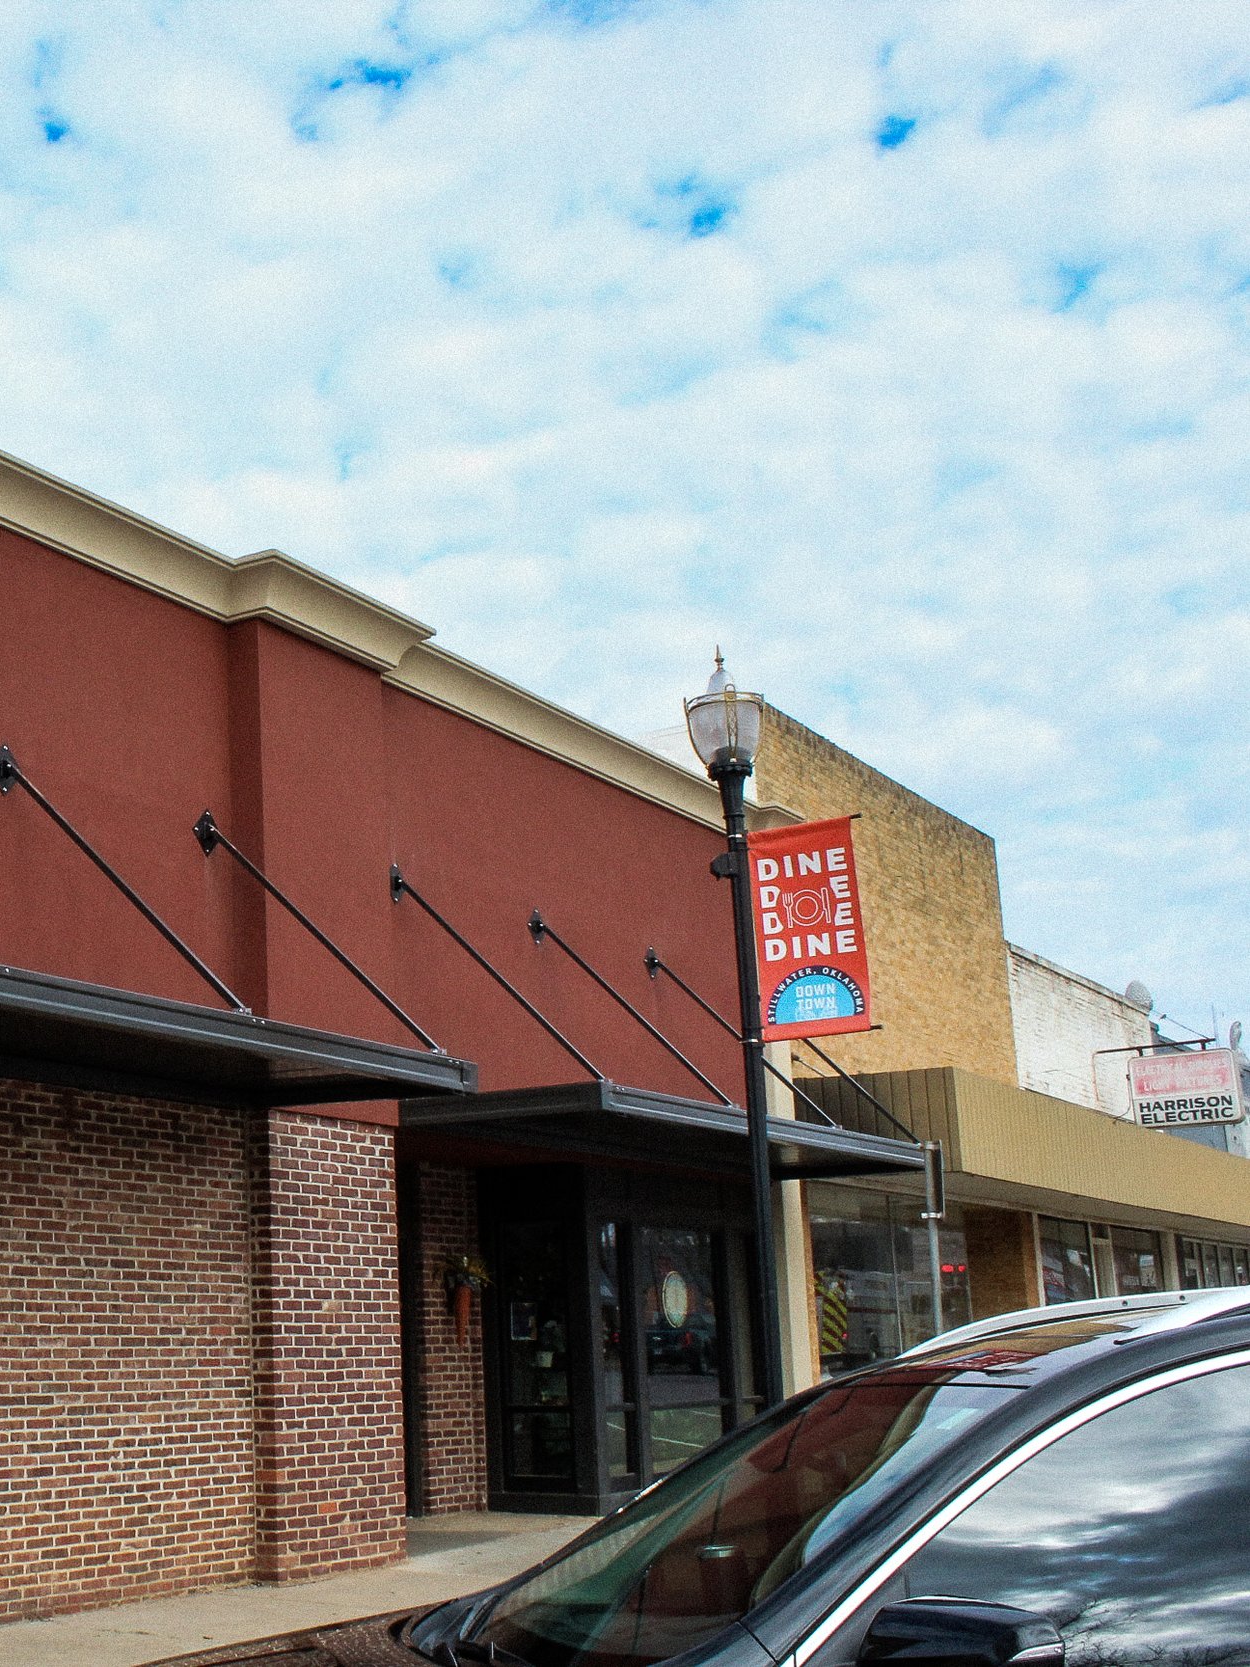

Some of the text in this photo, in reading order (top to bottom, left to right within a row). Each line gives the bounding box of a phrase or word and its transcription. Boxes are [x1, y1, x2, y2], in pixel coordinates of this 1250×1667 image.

[756, 847, 849, 881] DINE
[764, 930, 858, 962] DINE
[768, 966, 864, 1023] STILLWATER, OKLAHOMA
[795, 983, 837, 998] DOWN
[795, 996, 837, 1011] TOWN
[1139, 1095, 1233, 1113] HARRISON
[1141, 1107, 1234, 1124] ELECTRIC
